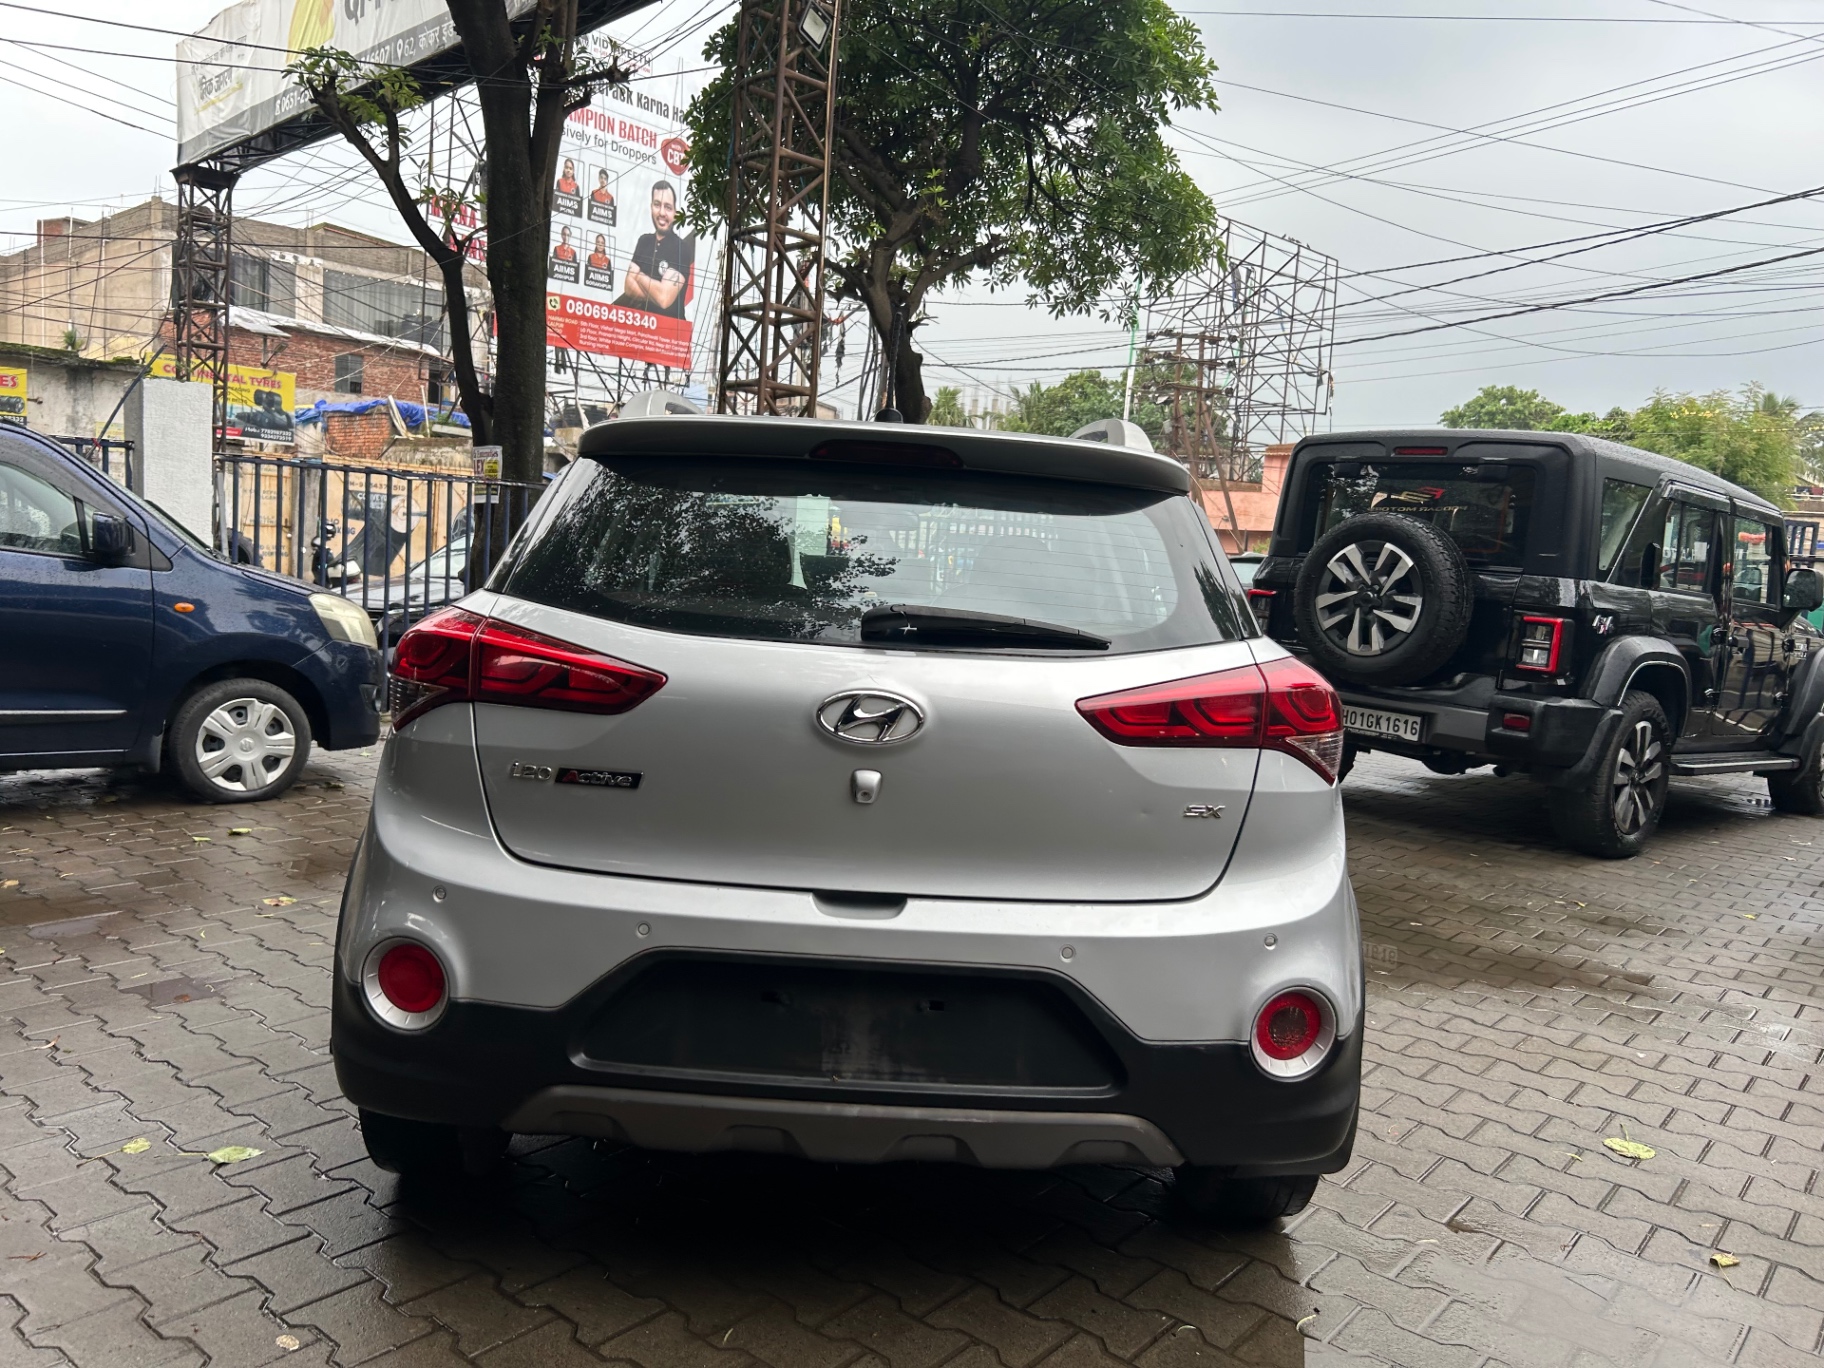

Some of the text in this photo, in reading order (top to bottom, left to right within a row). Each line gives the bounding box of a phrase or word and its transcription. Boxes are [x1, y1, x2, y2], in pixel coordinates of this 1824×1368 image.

[636, 92, 669, 119] Karna
[672, 105, 685, 124] Ha
[568, 107, 657, 149] MPION BATCH
[562, 125, 657, 165] sively for Droppers
[557, 197, 578, 209] AIIMS
[592, 206, 613, 218] AIIMS
[554, 264, 575, 275] AIIMS
[589, 272, 609, 283] AIIMS
[566, 299, 658, 330] 08069453340
[248, 376, 282, 389] TYRES
[1342, 709, 1419, 736] H01GK1616
[562, 769, 632, 787] Active
[1183, 804, 1226, 819] SX
